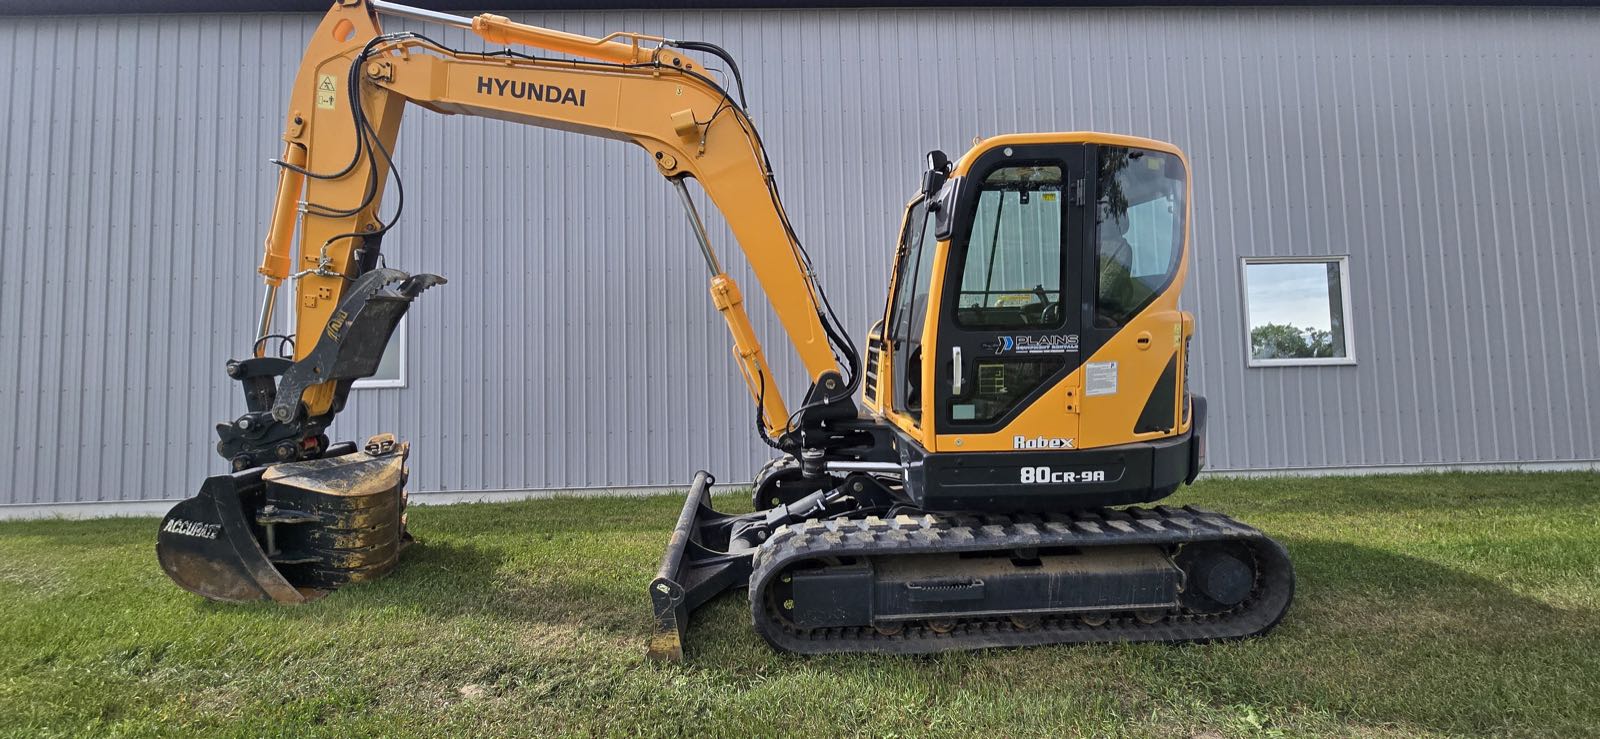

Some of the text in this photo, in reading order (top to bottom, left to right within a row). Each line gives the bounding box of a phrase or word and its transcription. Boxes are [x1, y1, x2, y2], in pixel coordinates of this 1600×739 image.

[477, 76, 586, 107] HYUNDAI
[1015, 334, 1079, 345] PLAINS
[1013, 435, 1075, 449] Robex
[1020, 466, 1105, 484] 80CR-9A
[163, 518, 221, 539] ACCURATE
